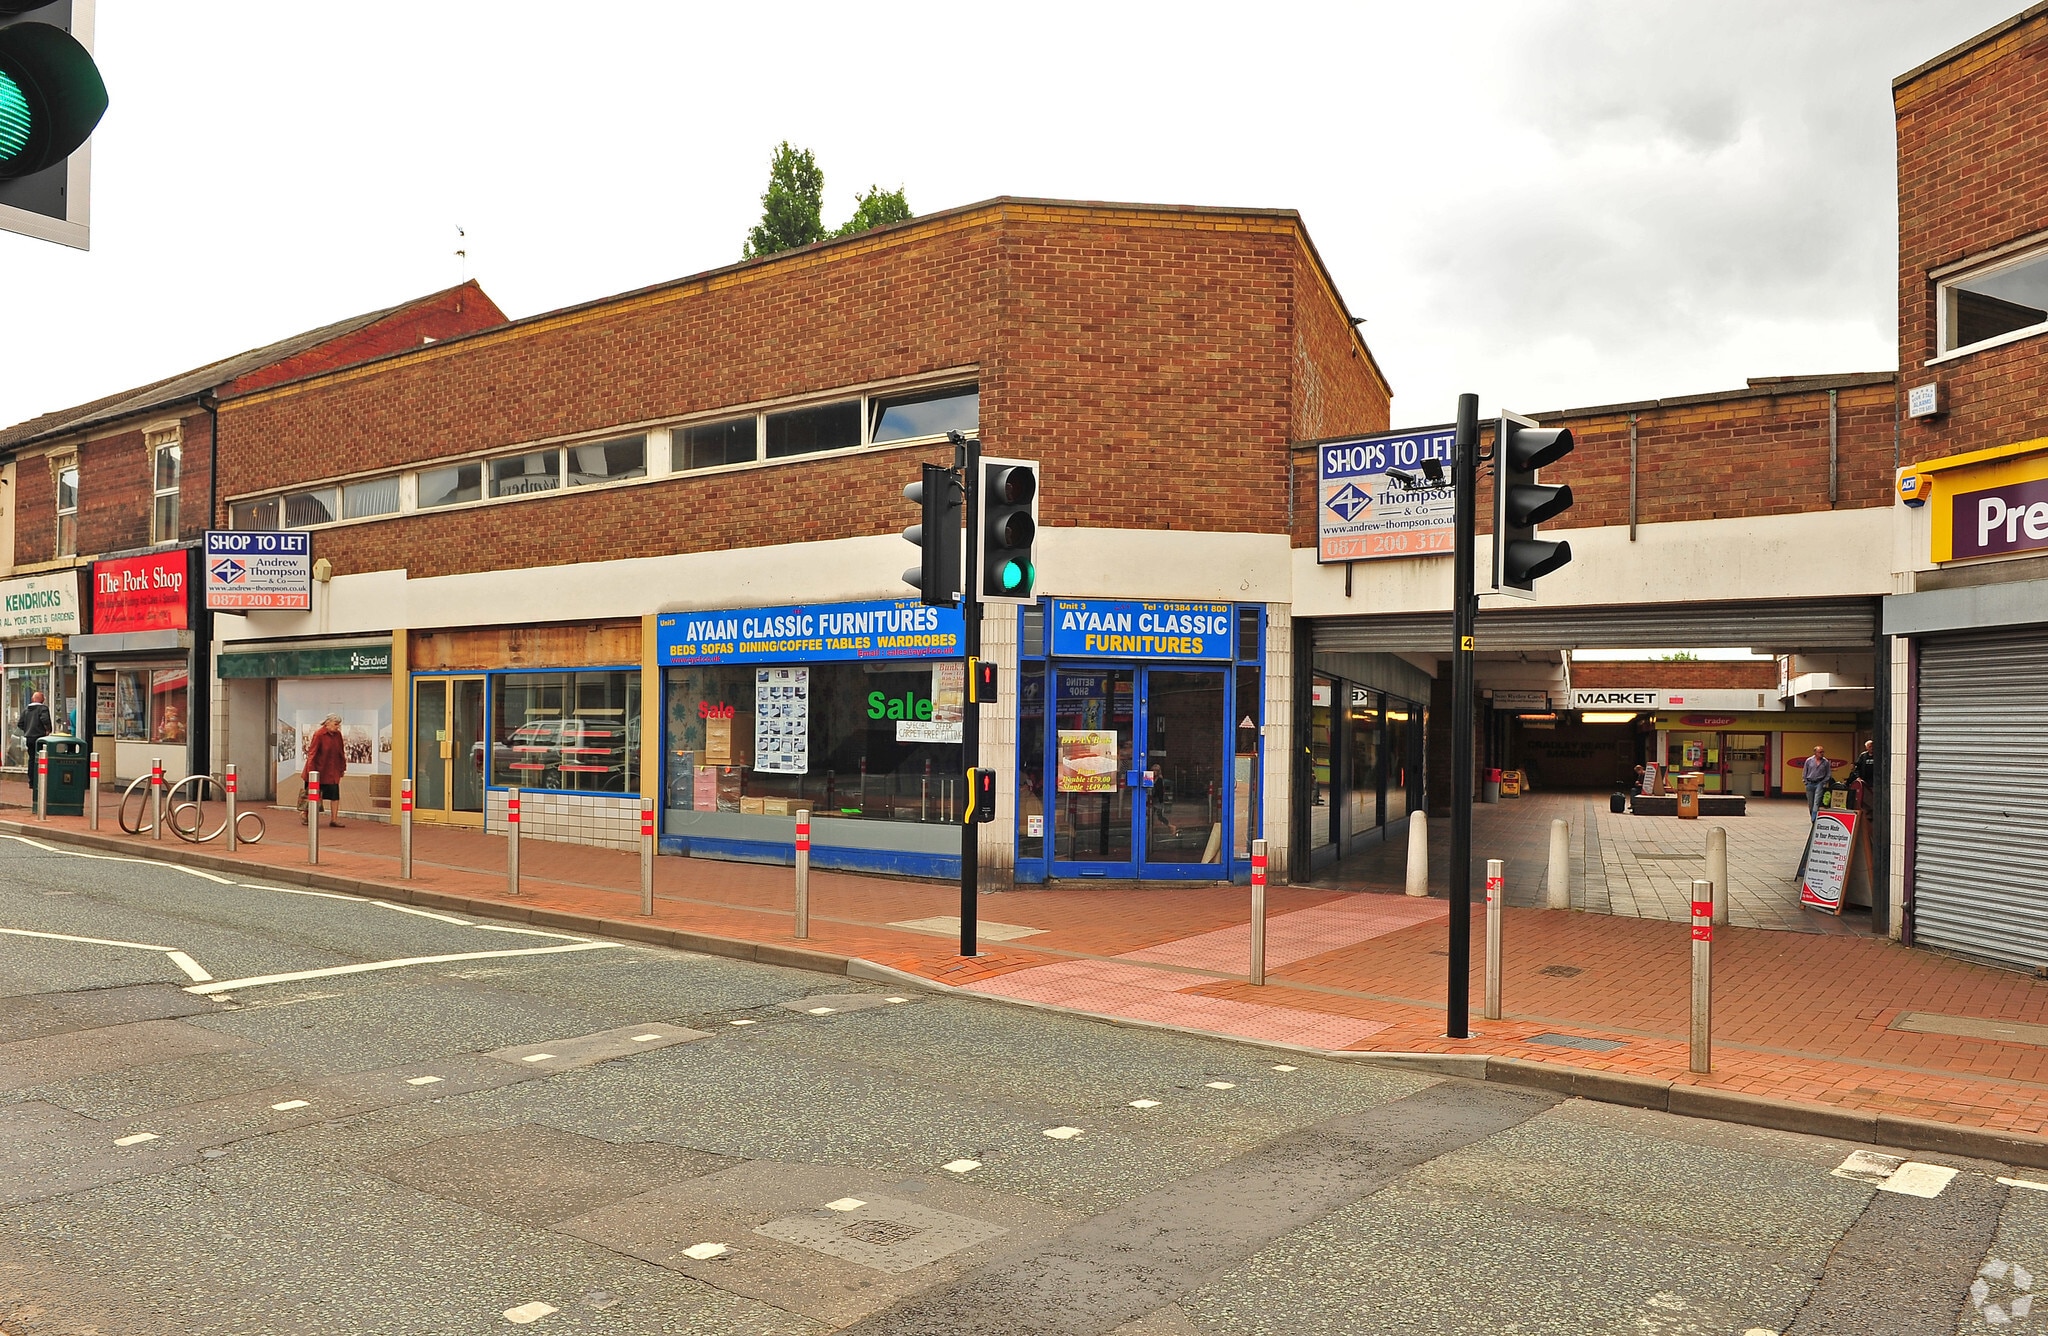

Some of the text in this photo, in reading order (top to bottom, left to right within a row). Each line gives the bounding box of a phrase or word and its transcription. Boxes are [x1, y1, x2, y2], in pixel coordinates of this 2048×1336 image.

[1327, 435, 1455, 474] SHOPS TO LET
[1902, 479, 1916, 490] ADT
[1404, 506, 1428, 515] & Co
[210, 535, 304, 551] SHOP TO LET
[1327, 531, 1454, 556] 0871 200 3171
[256, 558, 298, 567] Andrew
[98, 566, 183, 593] The Pork Shop
[249, 567, 306, 578] Thompson
[6, 590, 61, 612] KENDRICKS
[212, 595, 305, 606] 0871 200 3171
[1059, 602, 1078, 610] Unit
[1142, 603, 1156, 611] Tel
[1163, 604, 1191, 612] 01384
[1211, 605, 1227, 613] 800
[4, 617, 12, 627] ALL
[14, 616, 27, 625] YOUR
[30, 614, 42, 624] PETS
[51, 612, 75, 622] GARDENS
[686, 607, 938, 641] AYAAN CLASSIC FURNITURES
[1061, 611, 1228, 635] AYAAN CLASSIC
[670, 633, 957, 656] BEDS SOFAS DINING/COFFEE TABLES WARDROBES
[1085, 634, 1204, 654] FURNITURES
[1464, 638, 1472, 649] 4
[857, 649, 880, 657] Email
[867, 691, 933, 720] Sale
[1577, 693, 1656, 704] MARKET
[698, 701, 735, 719] Sale
[899, 729, 920, 738] CARPET
[924, 730, 939, 739] FREE
